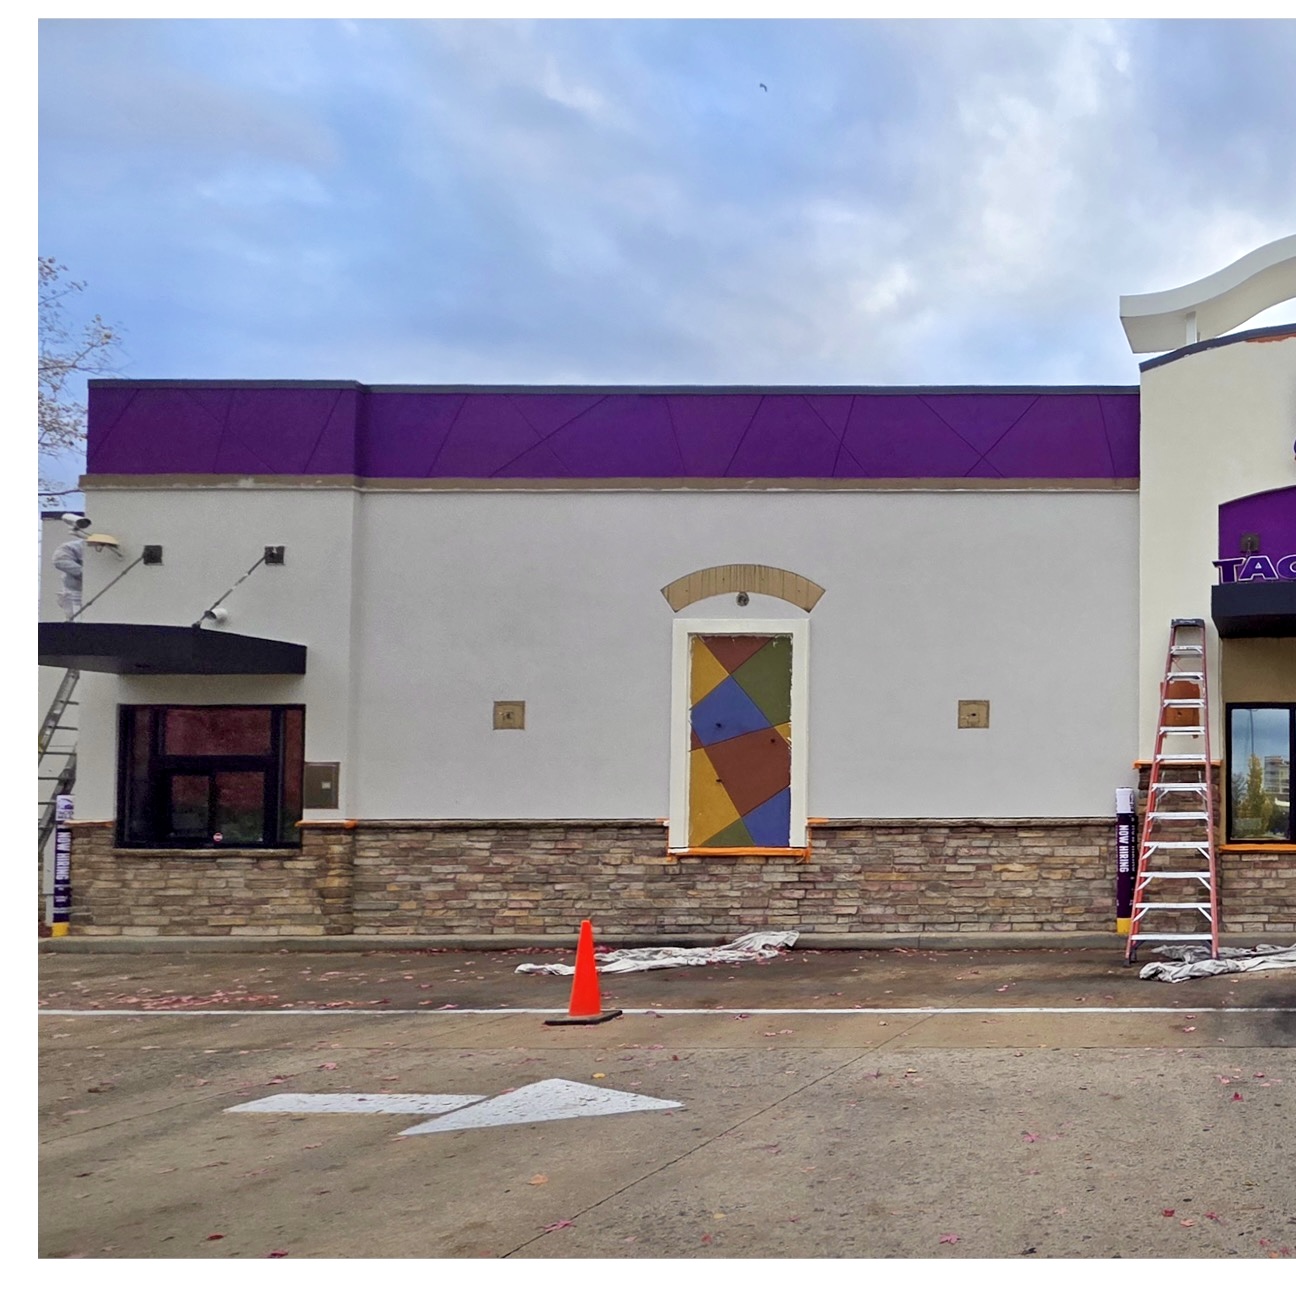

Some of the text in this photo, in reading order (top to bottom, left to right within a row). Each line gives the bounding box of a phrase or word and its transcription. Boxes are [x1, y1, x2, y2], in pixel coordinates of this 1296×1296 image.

[56, 831, 72, 852] NOW
[1118, 824, 1130, 873] NOW HIRING
[56, 852, 72, 881] HIRING
